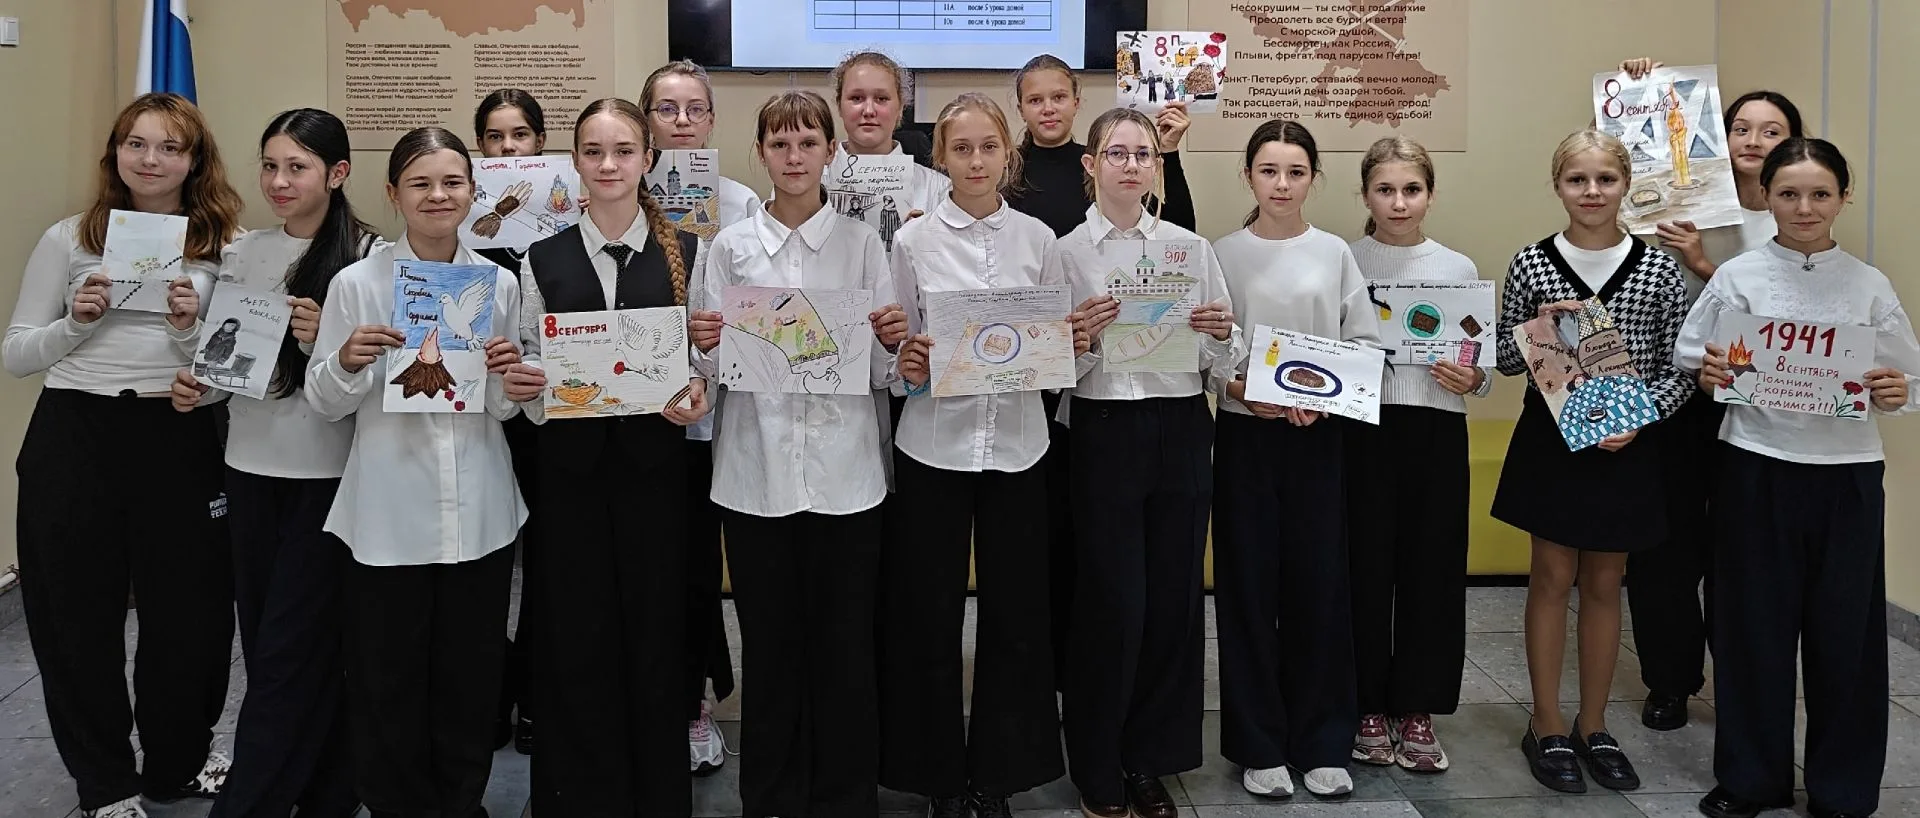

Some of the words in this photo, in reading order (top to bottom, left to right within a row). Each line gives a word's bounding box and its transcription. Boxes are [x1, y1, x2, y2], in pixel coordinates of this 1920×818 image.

[1230, 4, 1300, 13] Несокрушим
[1368, 5, 1391, 13] года
[1249, 16, 1313, 25] Преодолеть
[1337, 16, 1362, 25] бури
[1374, 16, 1407, 25] ветра!
[1280, 28, 1288, 36] С
[1291, 27, 1336, 38] морской
[1339, 28, 1377, 38] душой,
[1155, 36, 1168, 57] 8
[1263, 40, 1330, 49] Бессмертен,
[1353, 40, 1392, 49] Россия,
[1235, 51, 1273, 60] Плыви,
[1275, 52, 1314, 61] фрегат,
[1316, 53, 1336, 61] под
[1340, 53, 1383, 62] парусом
[1387, 52, 1421, 62] Петра!
[1223, 75, 1308, 84] анкт-Петербург,
[1310, 75, 1364, 84] оставайся
[1401, 75, 1438, 84] молод!
[1249, 87, 1301, 96] Грядущий
[1332, 88, 1370, 96] озарен
[1372, 87, 1406, 95] тобой.
[1223, 98, 1241, 107] Так
[1244, 98, 1301, 108] расцветай,
[1328, 99, 1395, 108] прекрасный
[1398, 99, 1431, 108] город!
[1603, 79, 1624, 118] 8
[1222, 110, 1268, 119] Высокая
[1344, 110, 1383, 120] единой
[1386, 110, 1432, 120] судьбой!
[842, 155, 858, 178] 8
[858, 166, 906, 174] СЕНТЯБРЯ
[1164, 251, 1187, 264] 900
[544, 315, 558, 338] 8
[558, 324, 608, 336] СЕНТЯБРЯ
[1526, 333, 1534, 345] 8
[1533, 341, 1564, 356] сентября
[1758, 321, 1836, 358] 1941
[1845, 350, 1855, 358] г.
[1776, 356, 1786, 372] 8
[1787, 365, 1839, 380] СЕНТЯБРЯ
[1753, 395, 1834, 414] Гордимся!!!
